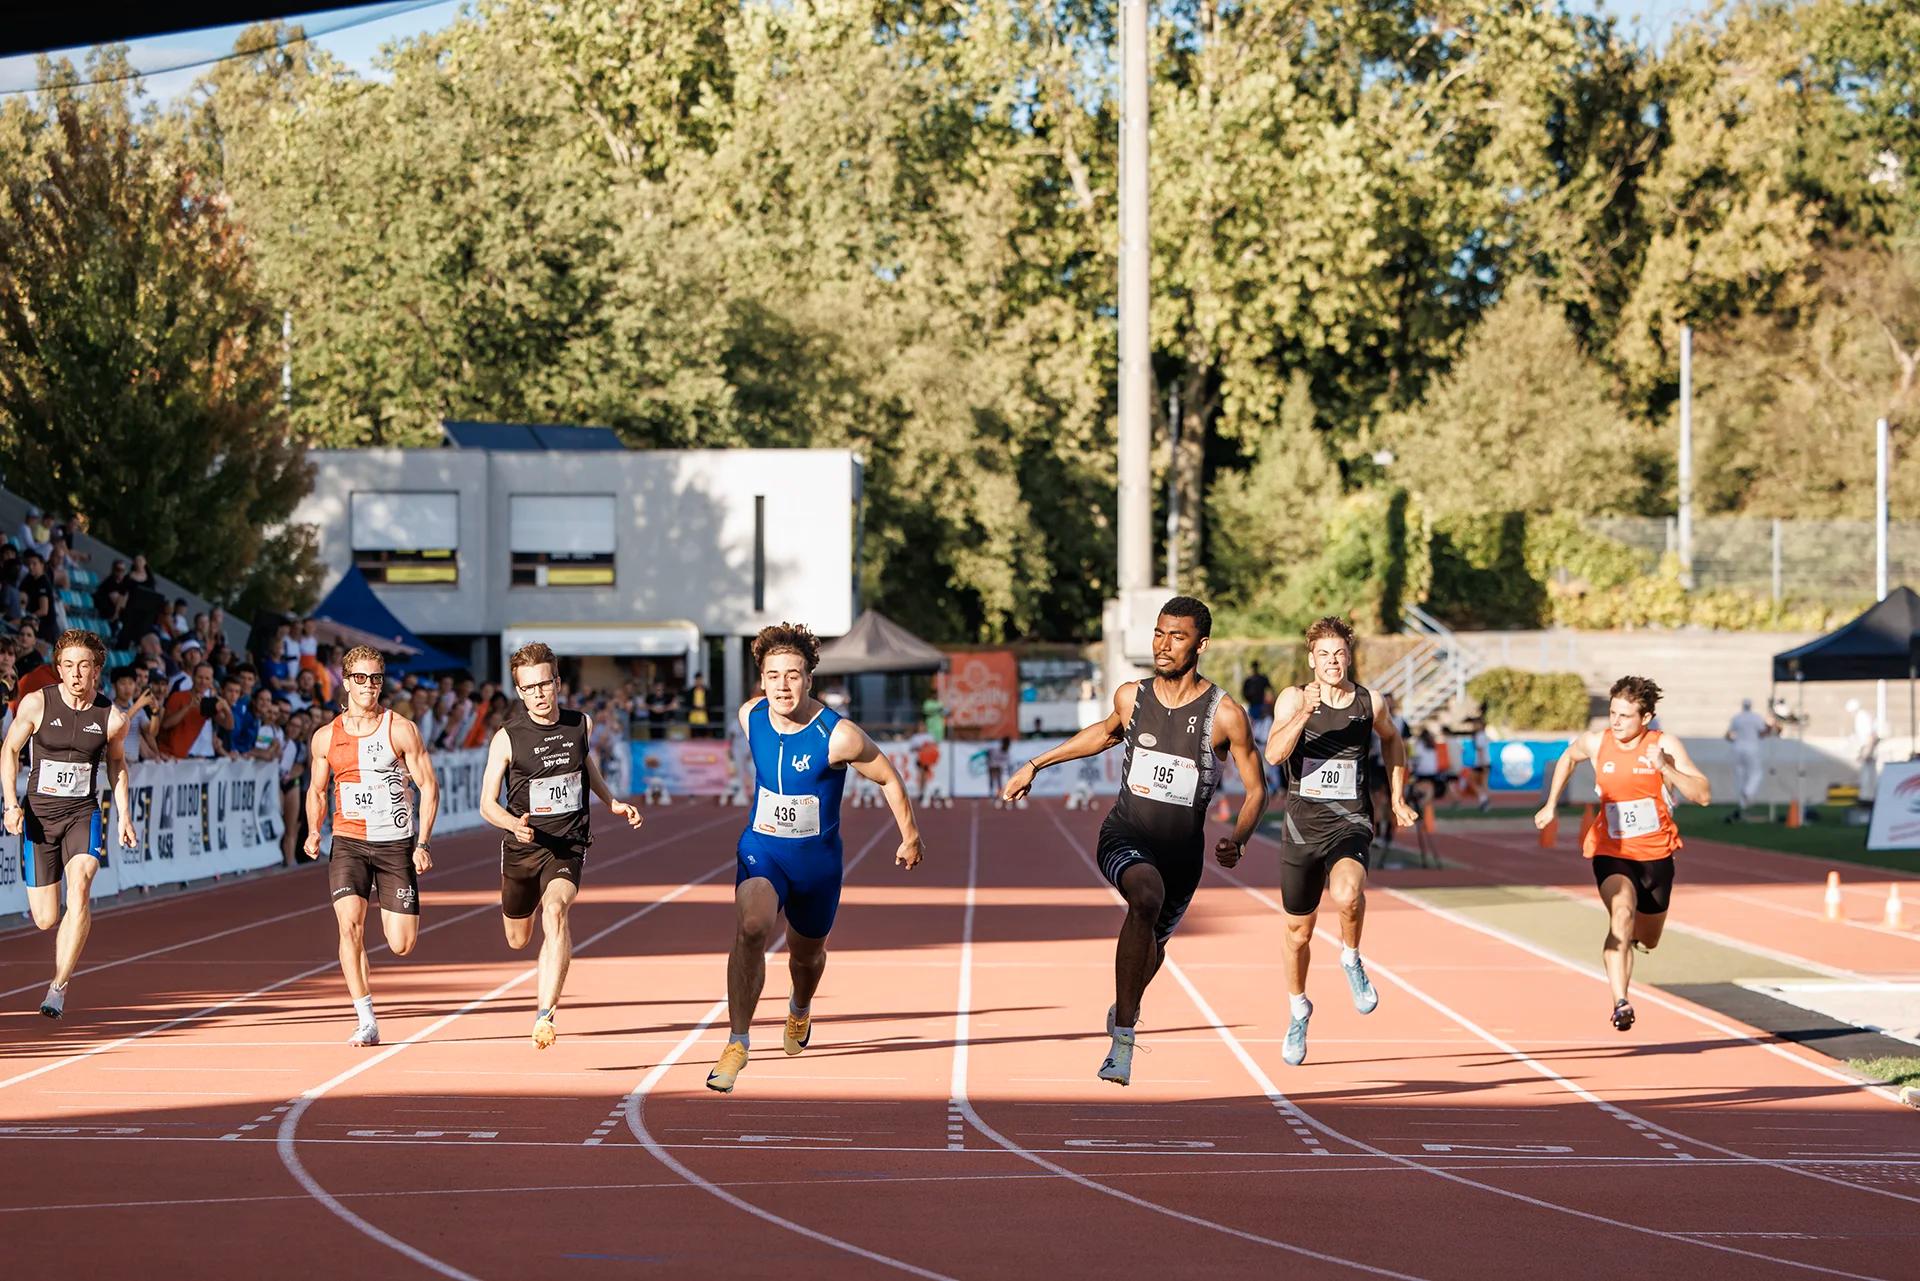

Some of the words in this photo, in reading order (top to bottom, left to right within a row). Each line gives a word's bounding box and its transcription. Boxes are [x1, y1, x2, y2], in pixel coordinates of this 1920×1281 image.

[56, 772, 74, 784] 517
[1152, 765, 1175, 784] 195
[1320, 771, 1340, 784] 780
[354, 792, 373, 805] 542
[549, 785, 568, 800] 704
[774, 806, 796, 822] 436
[1624, 811, 1637, 823] 25
